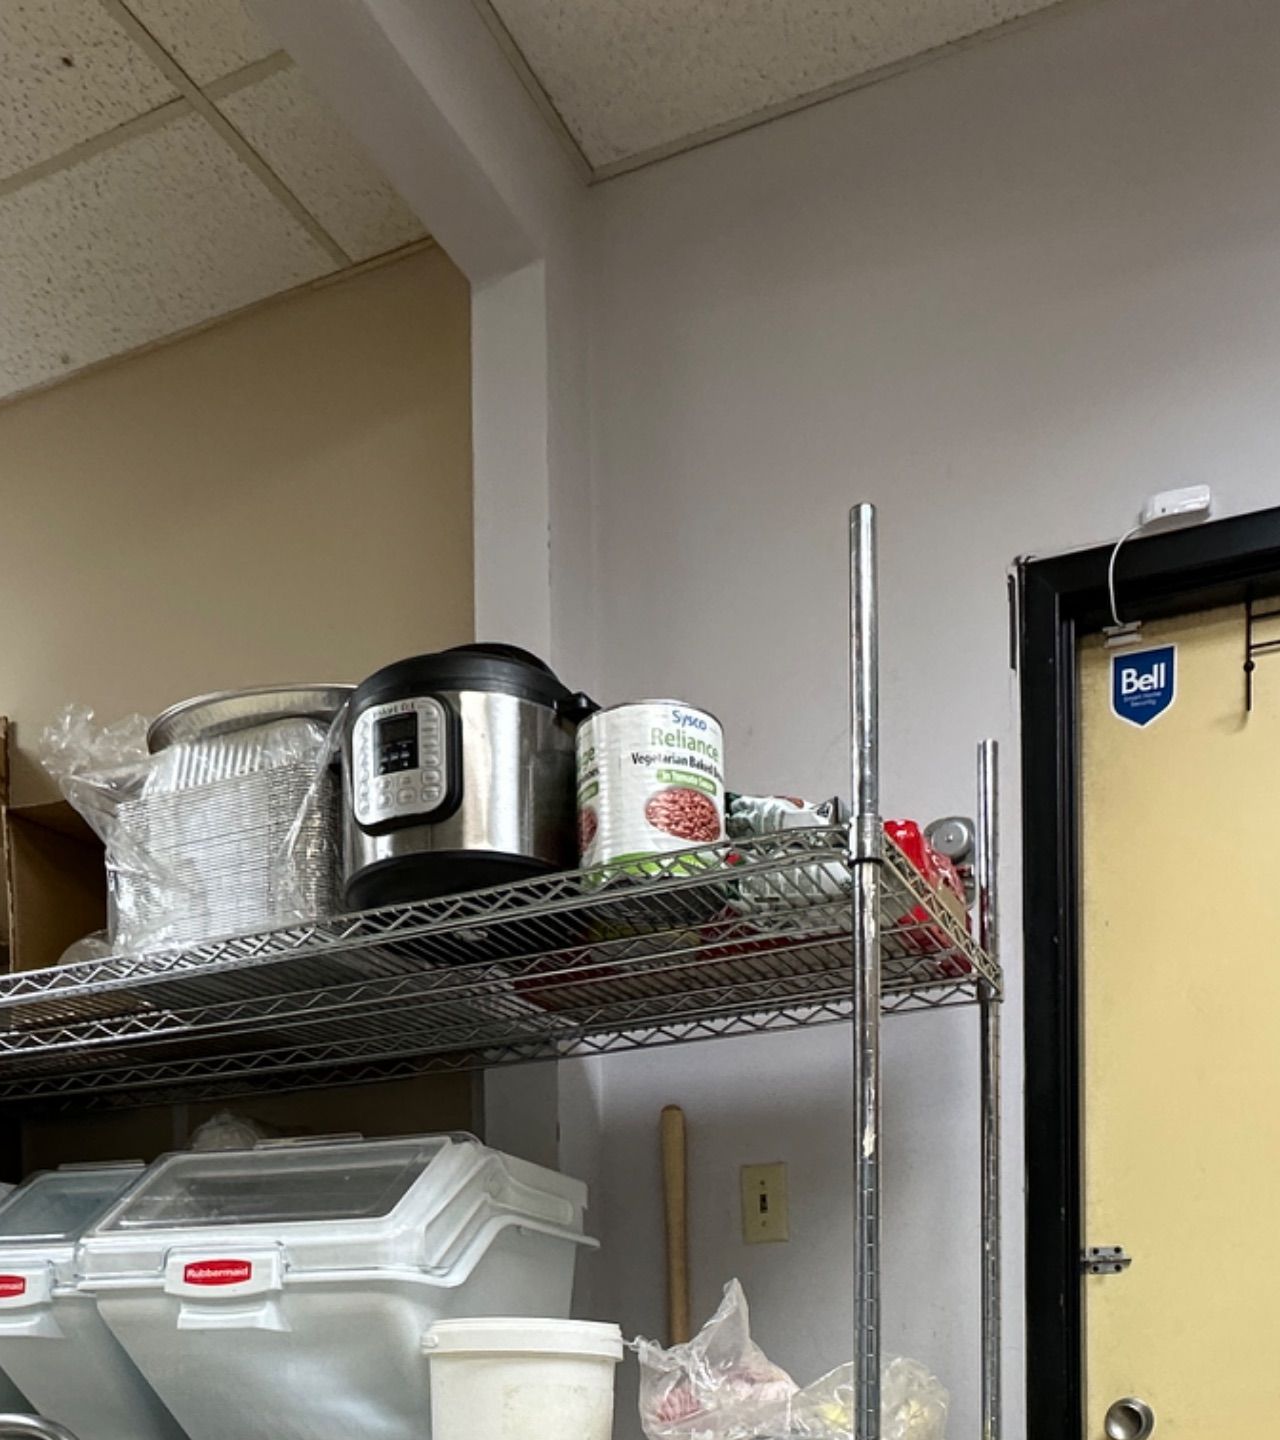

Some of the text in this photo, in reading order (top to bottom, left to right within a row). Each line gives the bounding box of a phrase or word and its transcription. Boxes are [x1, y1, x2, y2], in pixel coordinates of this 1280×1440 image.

[1121, 662, 1166, 696] Bell
[651, 727, 720, 762] Reliance
[632, 752, 689, 767] Vegetarian
[186, 1267, 249, 1279] Rubbermaid
